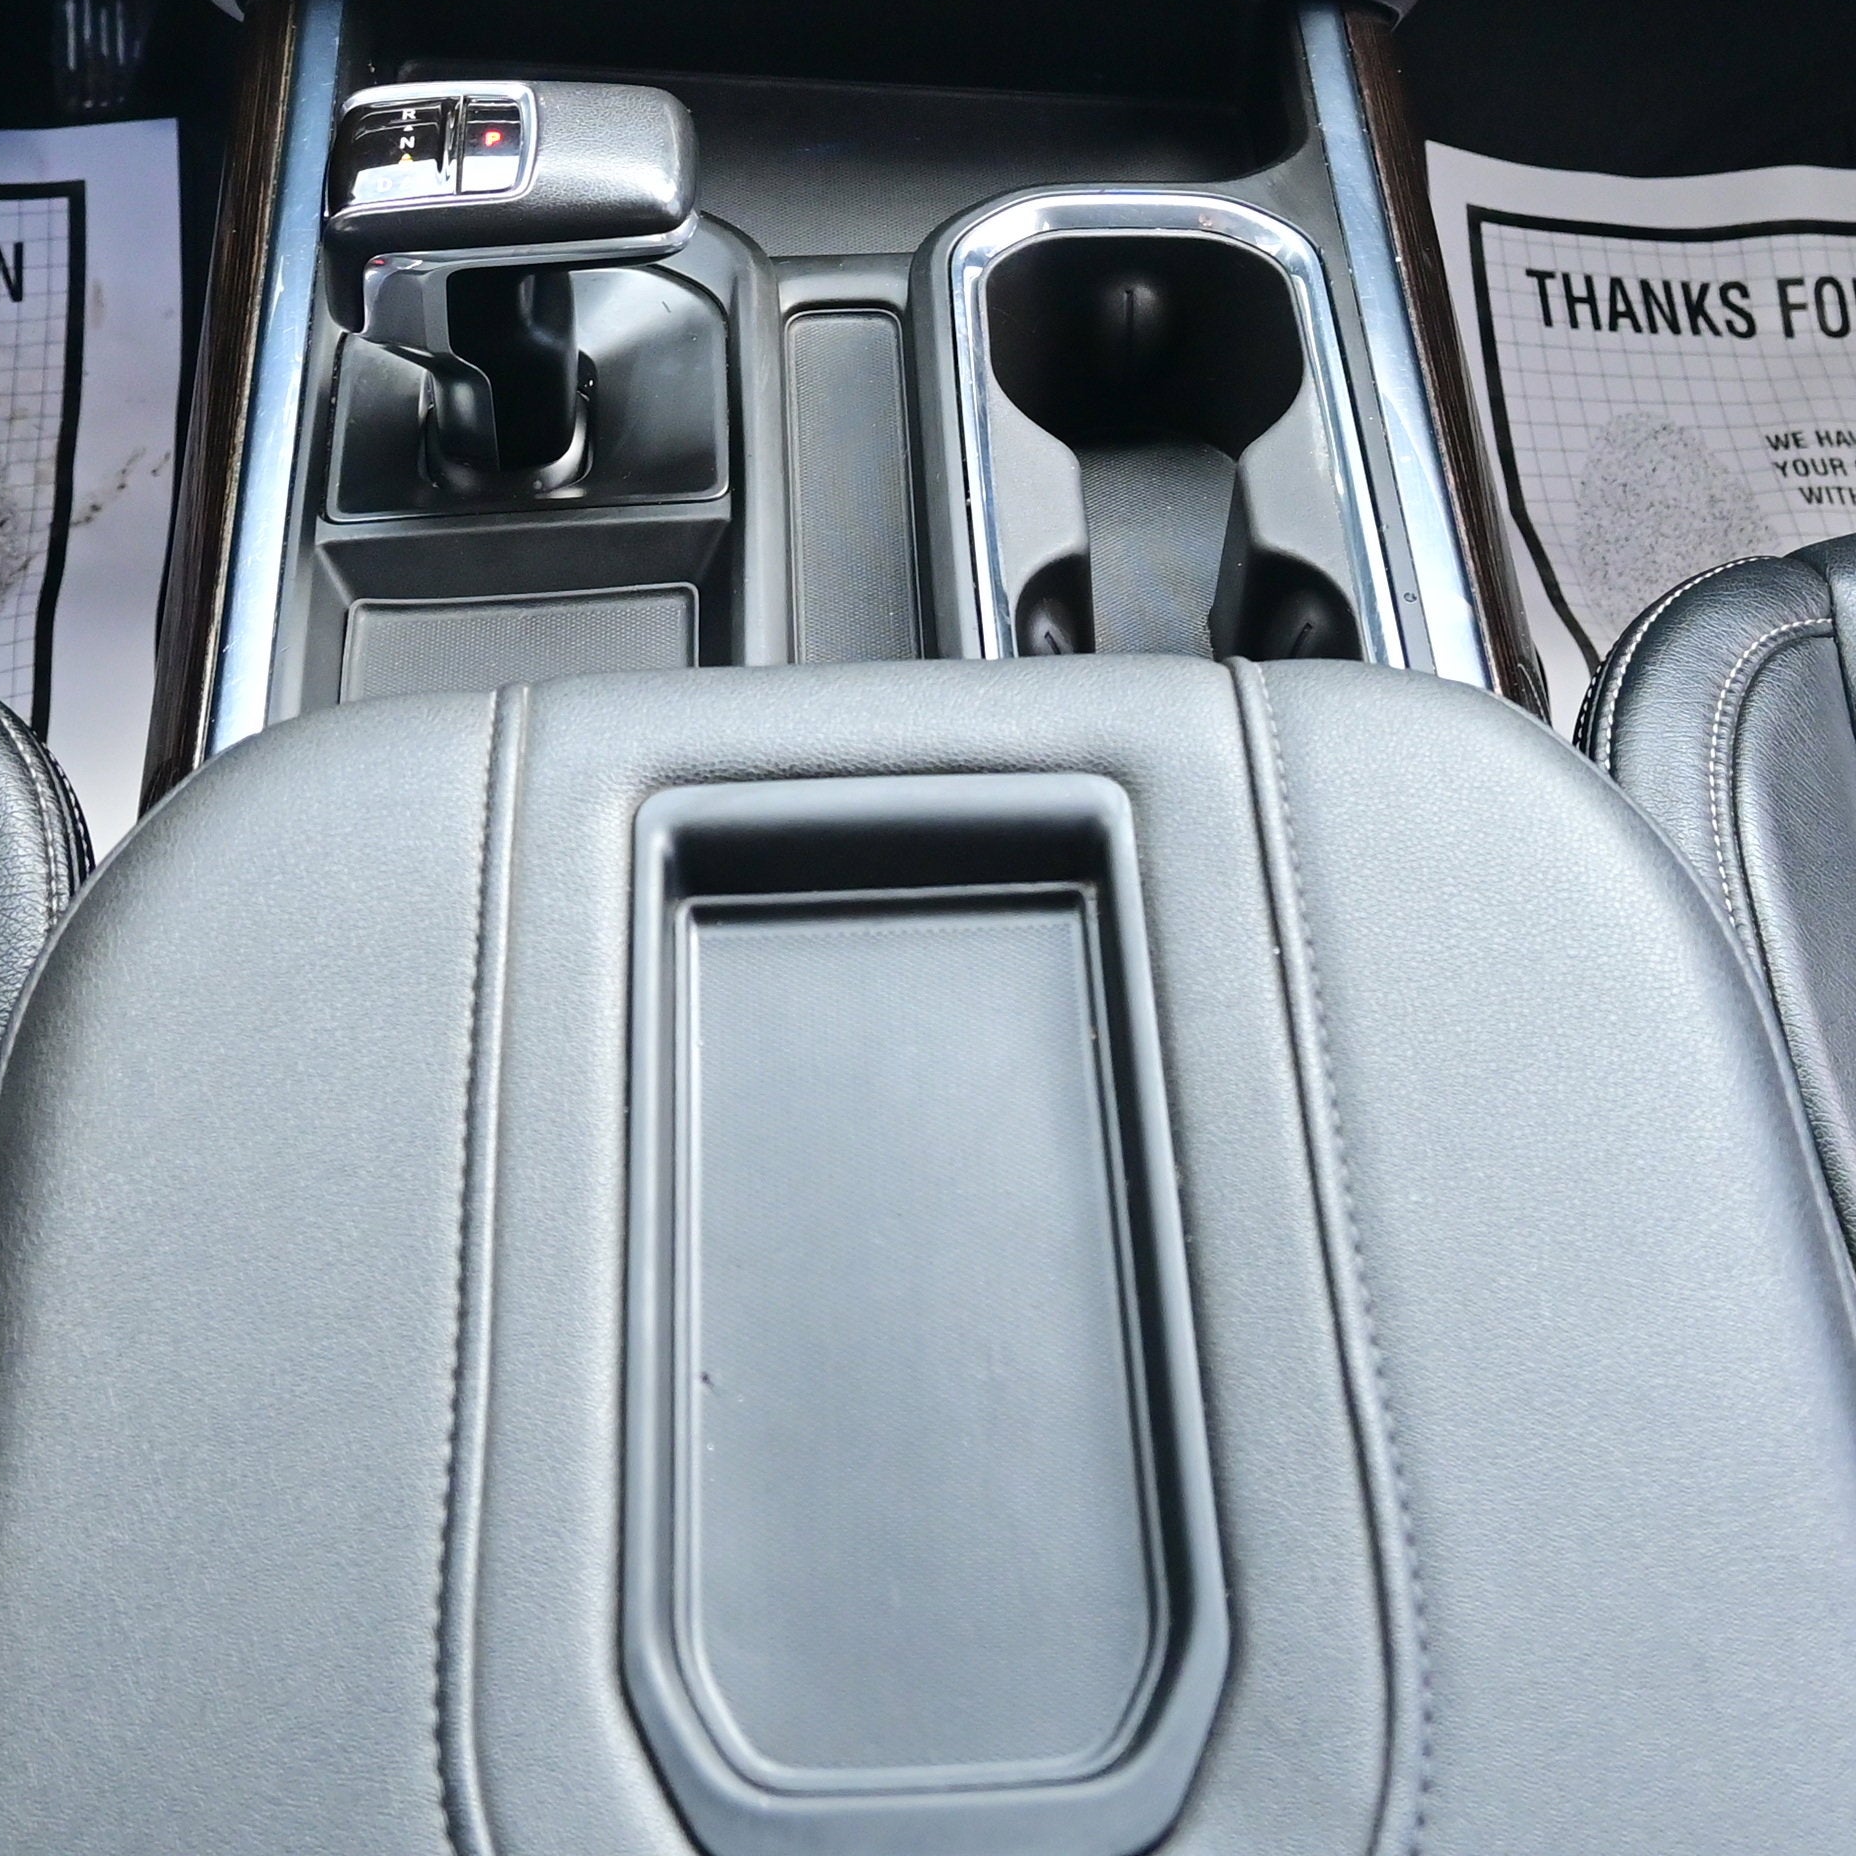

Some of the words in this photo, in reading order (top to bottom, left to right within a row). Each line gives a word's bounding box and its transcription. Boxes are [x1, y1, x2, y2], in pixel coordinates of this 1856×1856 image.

[401, 109, 416, 120] R
[399, 135, 416, 150] N
[484, 130, 502, 147] P
[1524, 268, 1758, 341] THANKS
[1766, 432, 1809, 452] WE
[1774, 457, 1848, 480] YOUR
